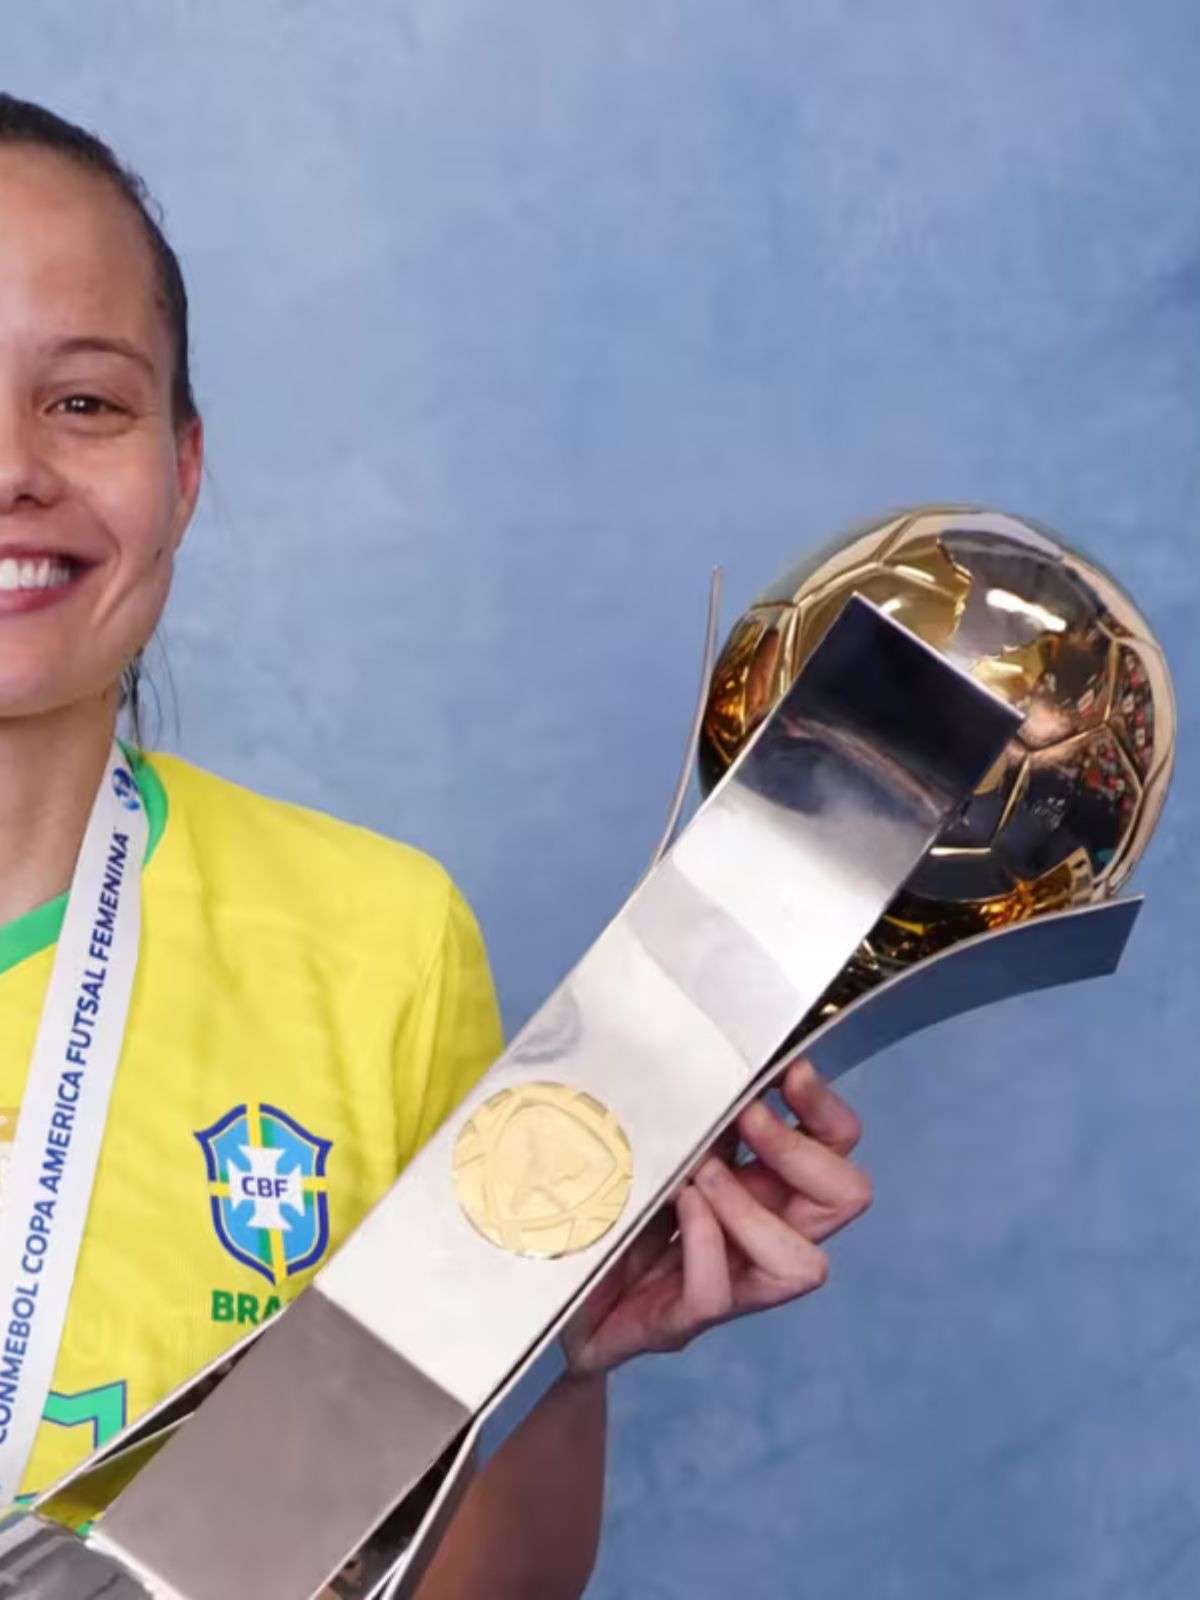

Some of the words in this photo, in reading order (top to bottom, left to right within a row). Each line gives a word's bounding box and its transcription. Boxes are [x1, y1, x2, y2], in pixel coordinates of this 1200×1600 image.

[90, 833, 129, 961] FEMENINA
[66, 968, 107, 1065] FUTSAL
[38, 1071, 84, 1194] AMERICA
[241, 1176, 288, 1198] CBF
[22, 1200, 56, 1275] COPA
